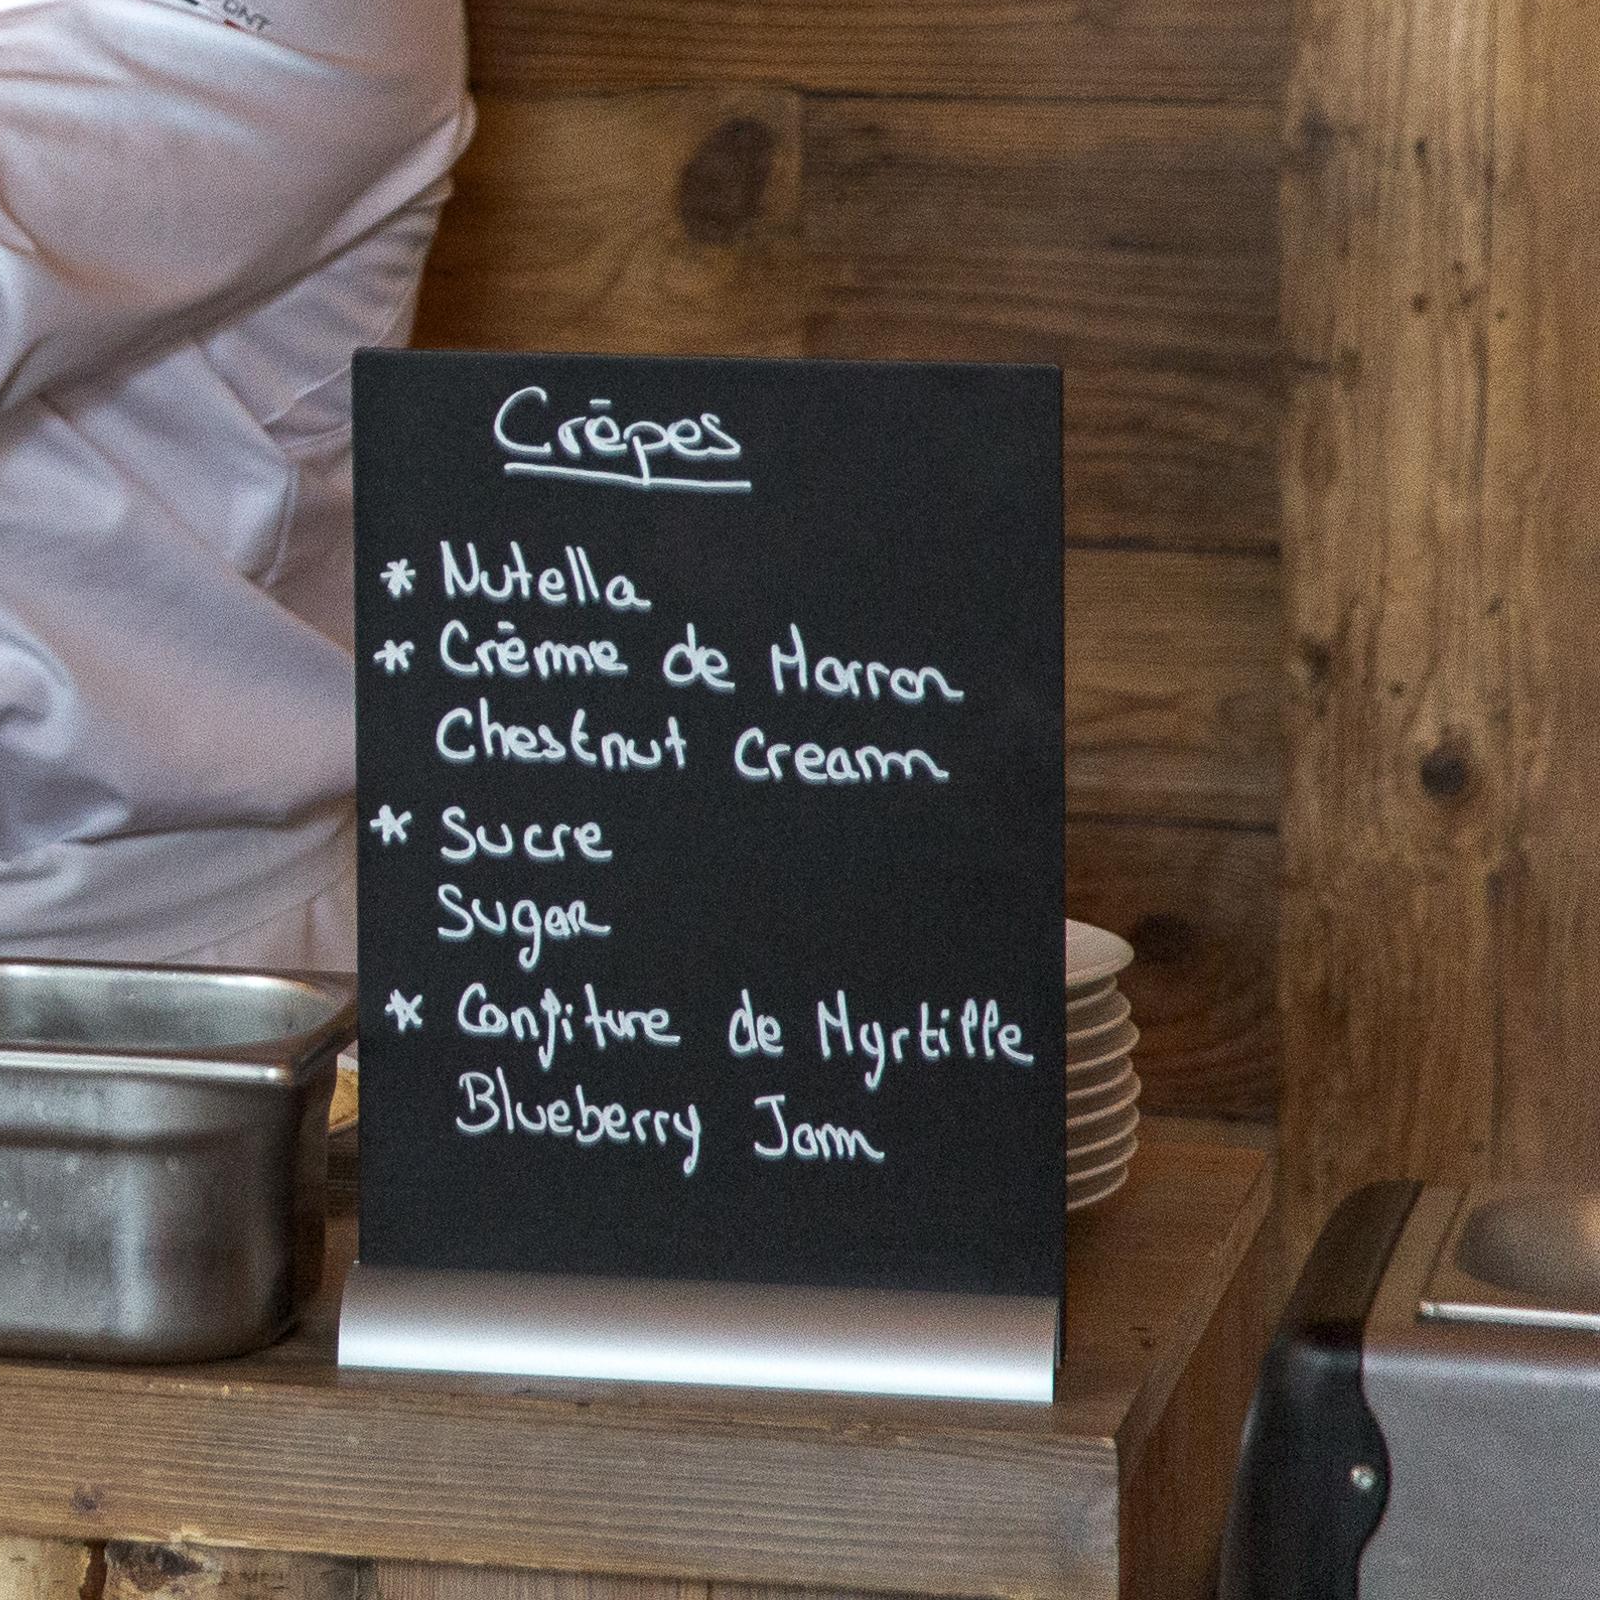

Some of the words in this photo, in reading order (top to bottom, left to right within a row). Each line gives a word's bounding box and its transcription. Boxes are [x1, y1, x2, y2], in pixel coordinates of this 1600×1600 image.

[439, 540, 653, 612] Nutella
[662, 622, 736, 693] de
[770, 622, 965, 703] Marron
[435, 696, 687, 770] Chestnut
[733, 726, 951, 785] Cream
[439, 805, 613, 863] Sucre
[437, 883, 612, 973] Sugar
[457, 982, 682, 1072] Confiture
[728, 988, 784, 1058] de
[817, 989, 1035, 1092] Myrtille
[455, 1066, 702, 1178] Blueberry
[753, 1093, 886, 1163] Jam
